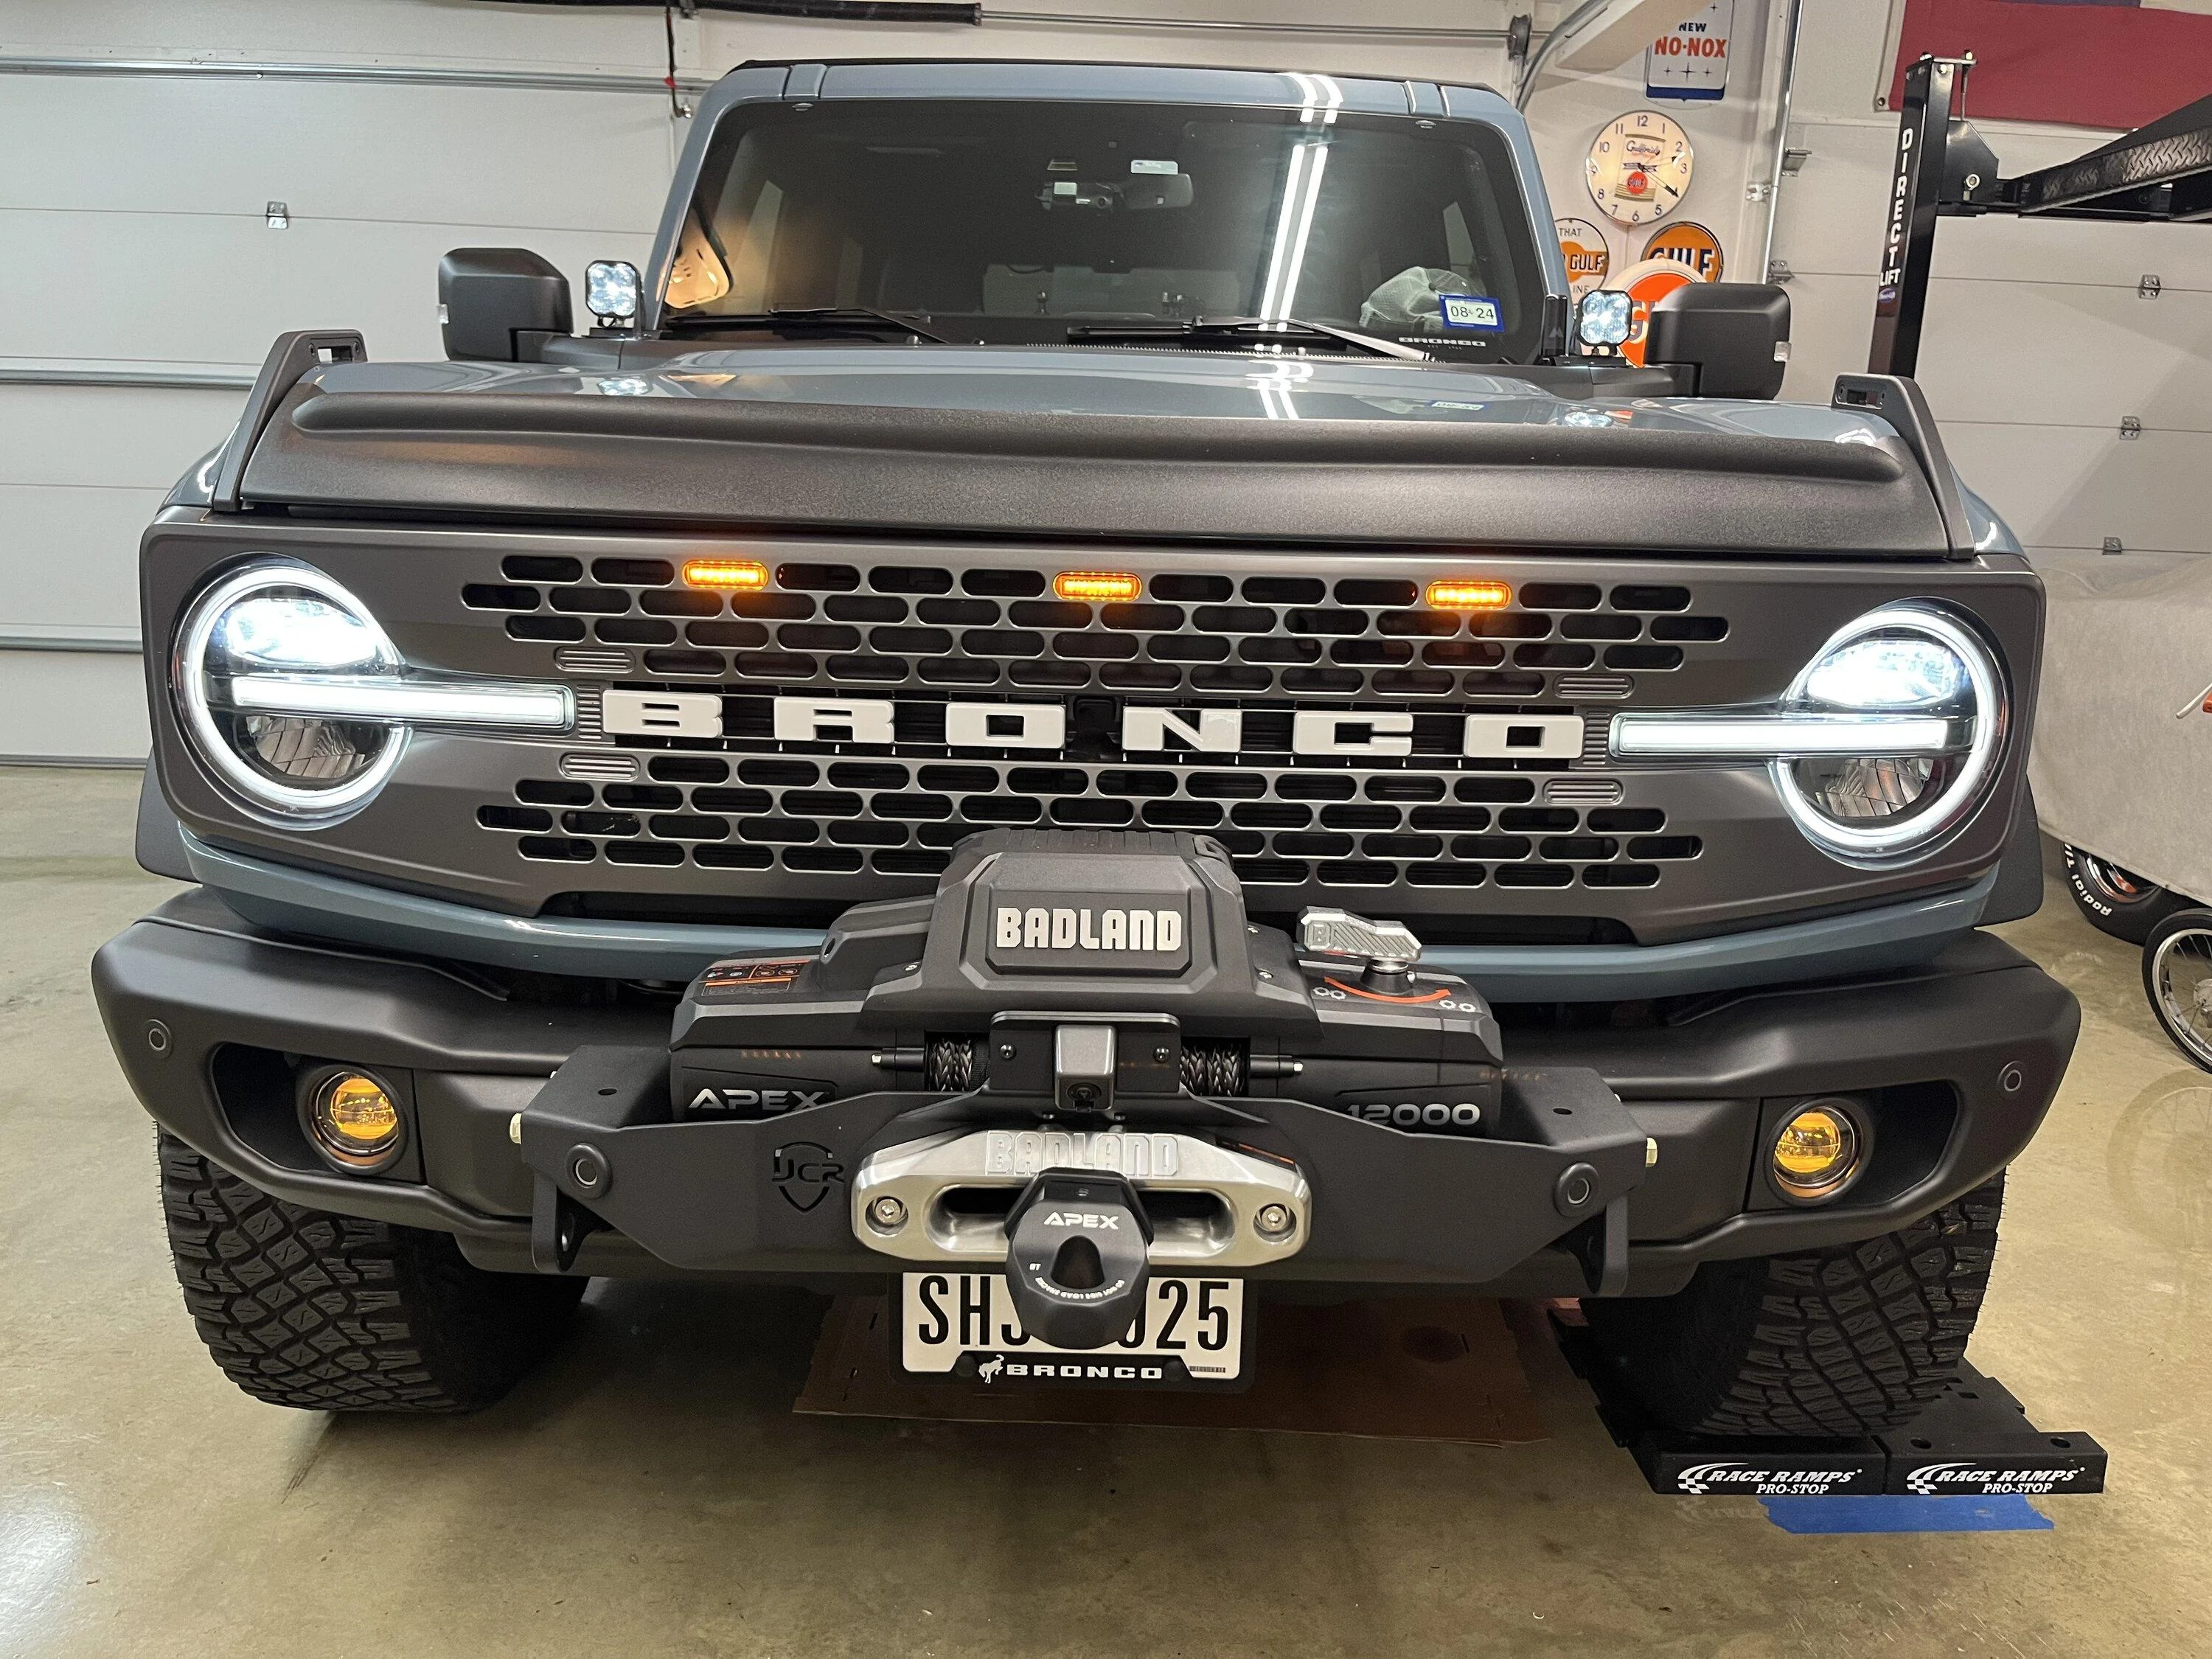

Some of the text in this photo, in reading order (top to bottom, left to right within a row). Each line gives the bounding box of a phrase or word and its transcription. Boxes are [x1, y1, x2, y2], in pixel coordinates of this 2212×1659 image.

[1678, 22, 1707, 32] NEW
[1637, 115, 1648, 127] 12
[1615, 123, 1624, 134] 11
[1599, 141, 1610, 153] 10
[1675, 142, 1683, 152] 2
[1680, 163, 1688, 174] 3
[1597, 189, 1604, 200] 8
[1888, 128, 1913, 268] DIRECT
[1611, 204, 1618, 215] 7
[1655, 204, 1663, 216] 5
[1632, 210, 1640, 222] 6
[1558, 227, 1582, 237] THAT
[1570, 254, 1606, 274] GULF
[1879, 268, 1901, 287] LIFT
[1450, 306, 1495, 319] 08 24
[1398, 336, 1486, 347] BRONCO
[602, 689, 1585, 759] BRONCO
[2071, 874, 2112, 917] Radial
[996, 907, 1183, 952] BADLAND
[688, 1088, 830, 1111] APEX
[985, 1130, 1179, 1178] BADLAND
[1043, 1211, 1119, 1231] APEX
[1006, 1364, 1162, 1380] BRONCO
[1706, 1470, 1856, 1483] RACE RAMPS
[1935, 1469, 2078, 1483] RACE RAMPS
[1756, 1484, 1829, 1495] PRO-STOP
[1982, 1482, 2053, 1494] PRO-STOP
